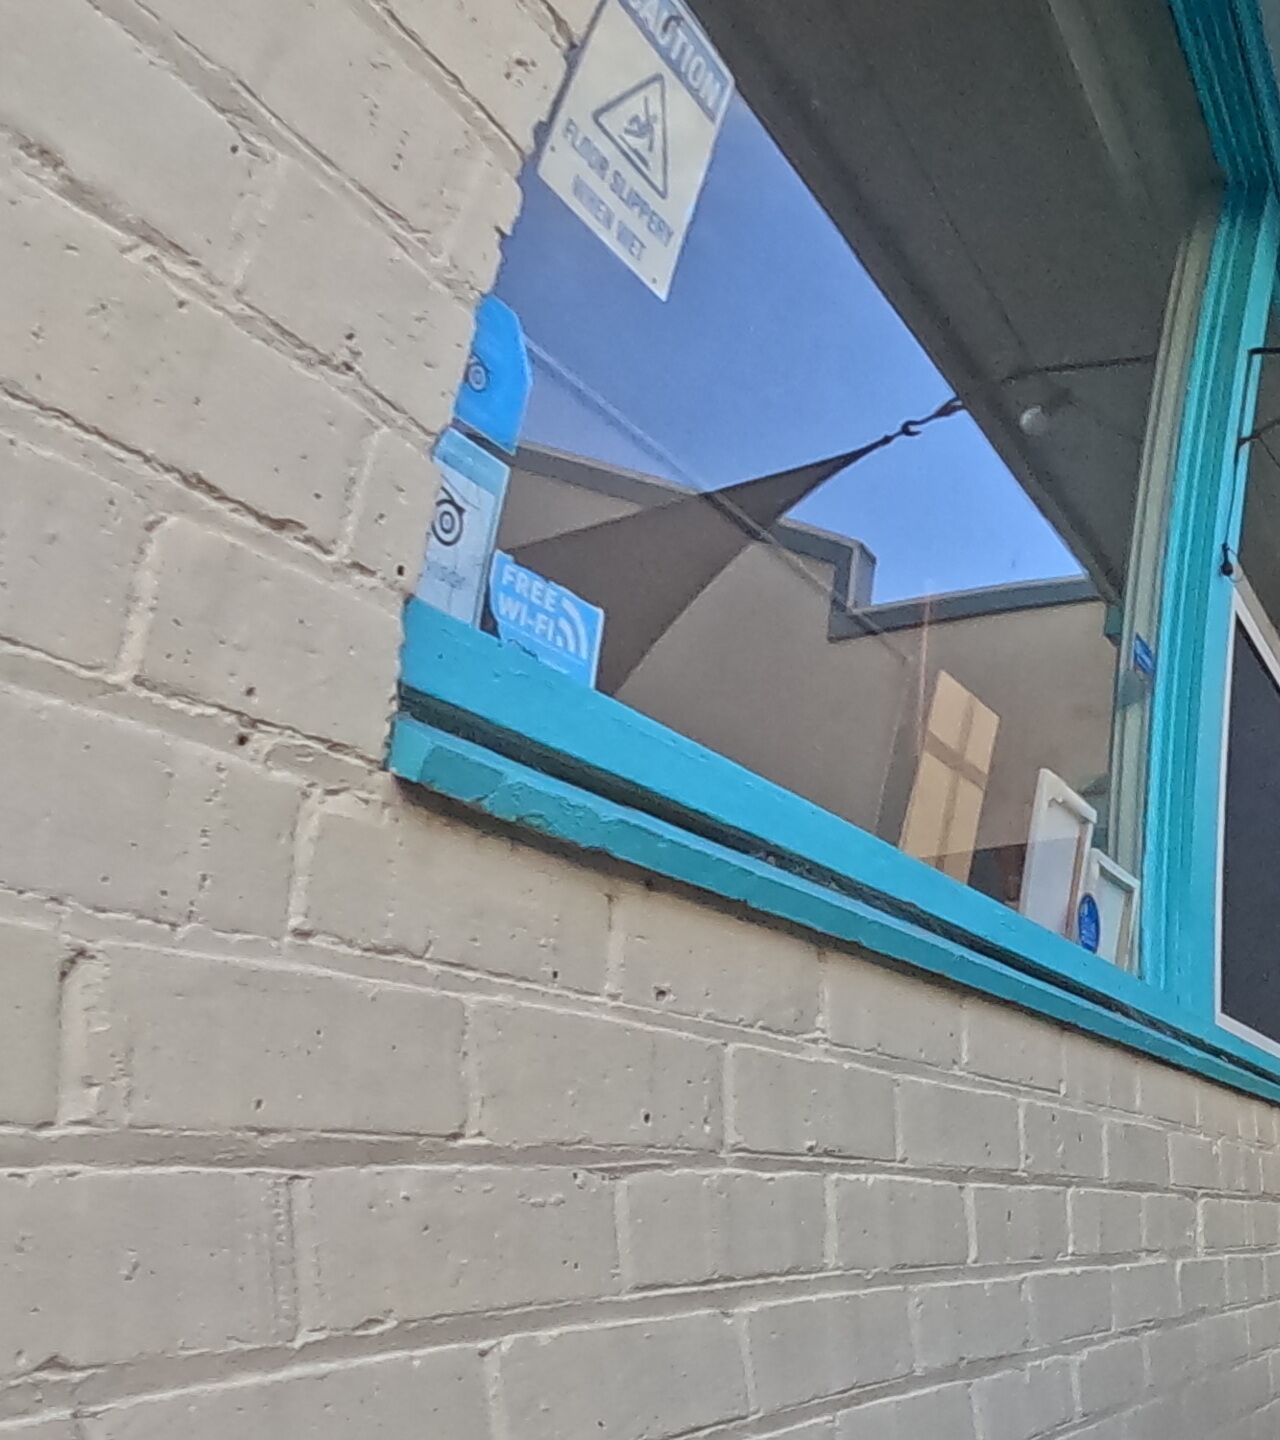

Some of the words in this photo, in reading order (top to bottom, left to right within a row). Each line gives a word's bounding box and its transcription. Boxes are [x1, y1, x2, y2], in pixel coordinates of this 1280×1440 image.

[562, 118, 610, 180] FLOOR
[609, 169, 674, 247] SLIPPERY
[571, 173, 616, 231] WHEN
[616, 220, 648, 261] WET
[498, 591, 555, 641] WI-FI
[501, 564, 558, 612] FREE
